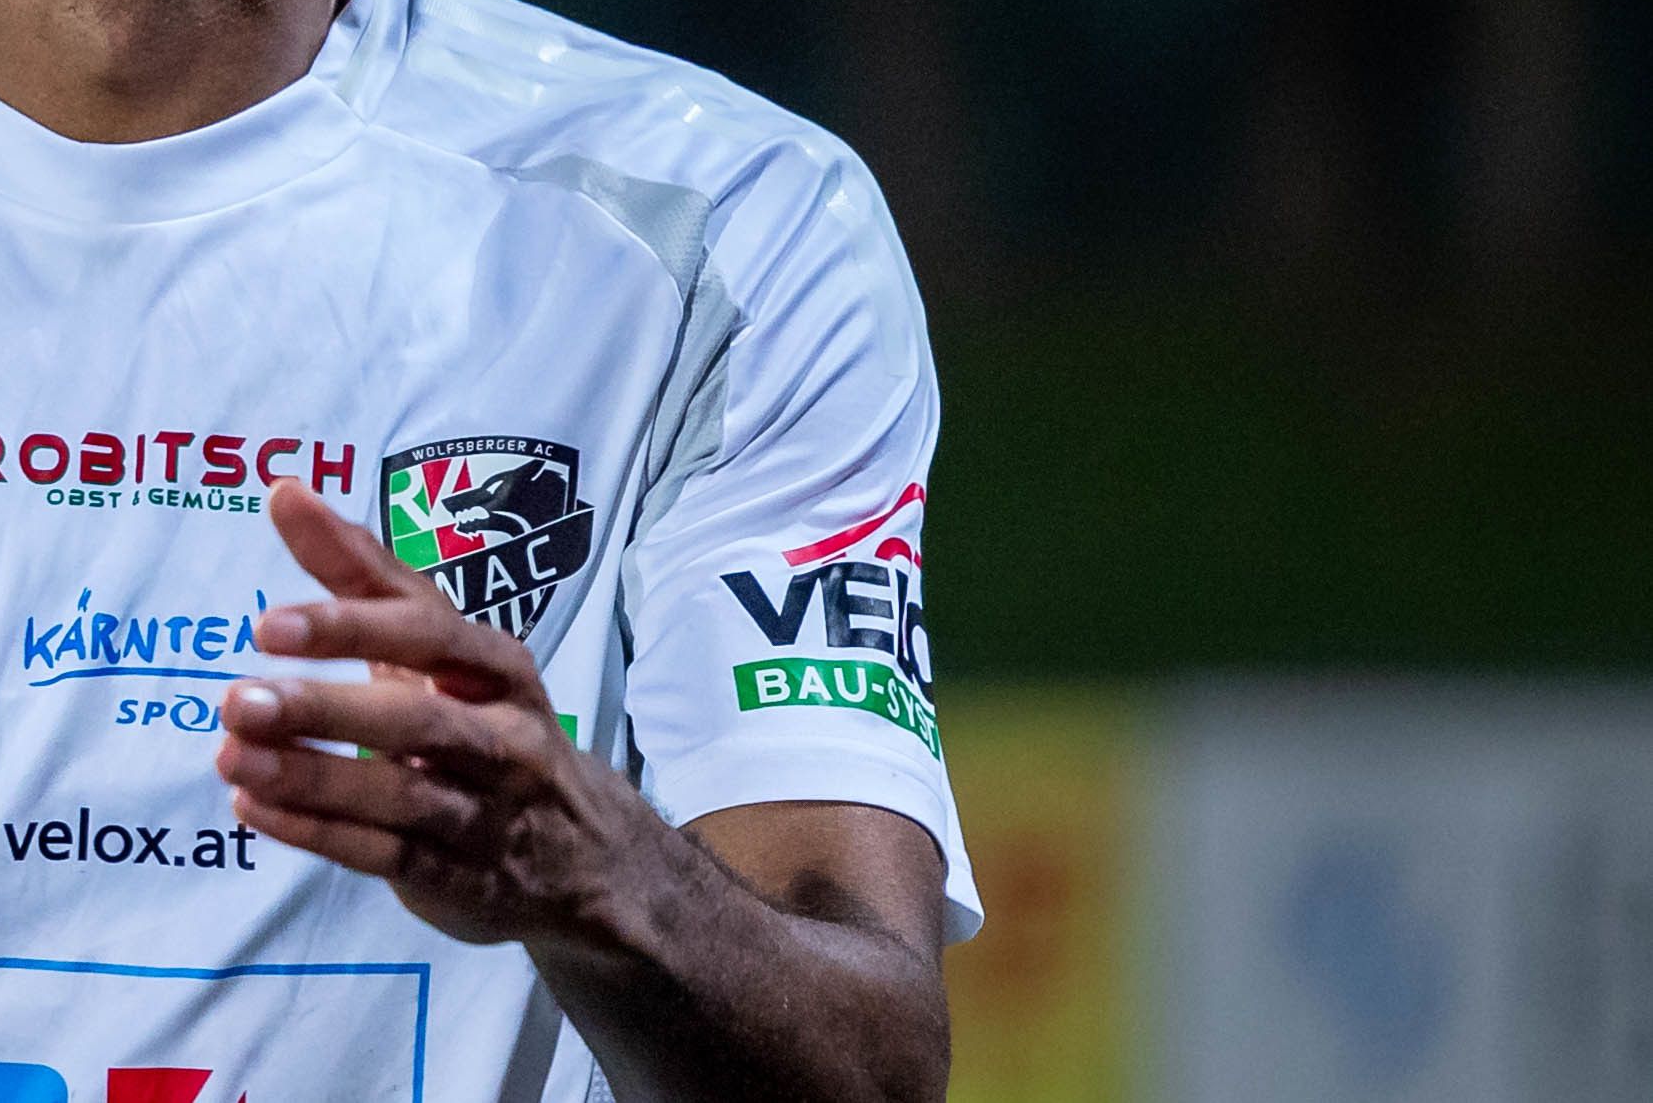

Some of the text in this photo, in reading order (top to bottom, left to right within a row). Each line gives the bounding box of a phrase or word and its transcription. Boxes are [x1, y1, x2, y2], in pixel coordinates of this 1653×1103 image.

[411, 438, 554, 461] WOLFSBERGER AC
[46, 488, 122, 509] OBST
[148, 488, 261, 514] GEMÜSE
[115, 694, 221, 732] SPO
[3, 806, 257, 871] velox.at
